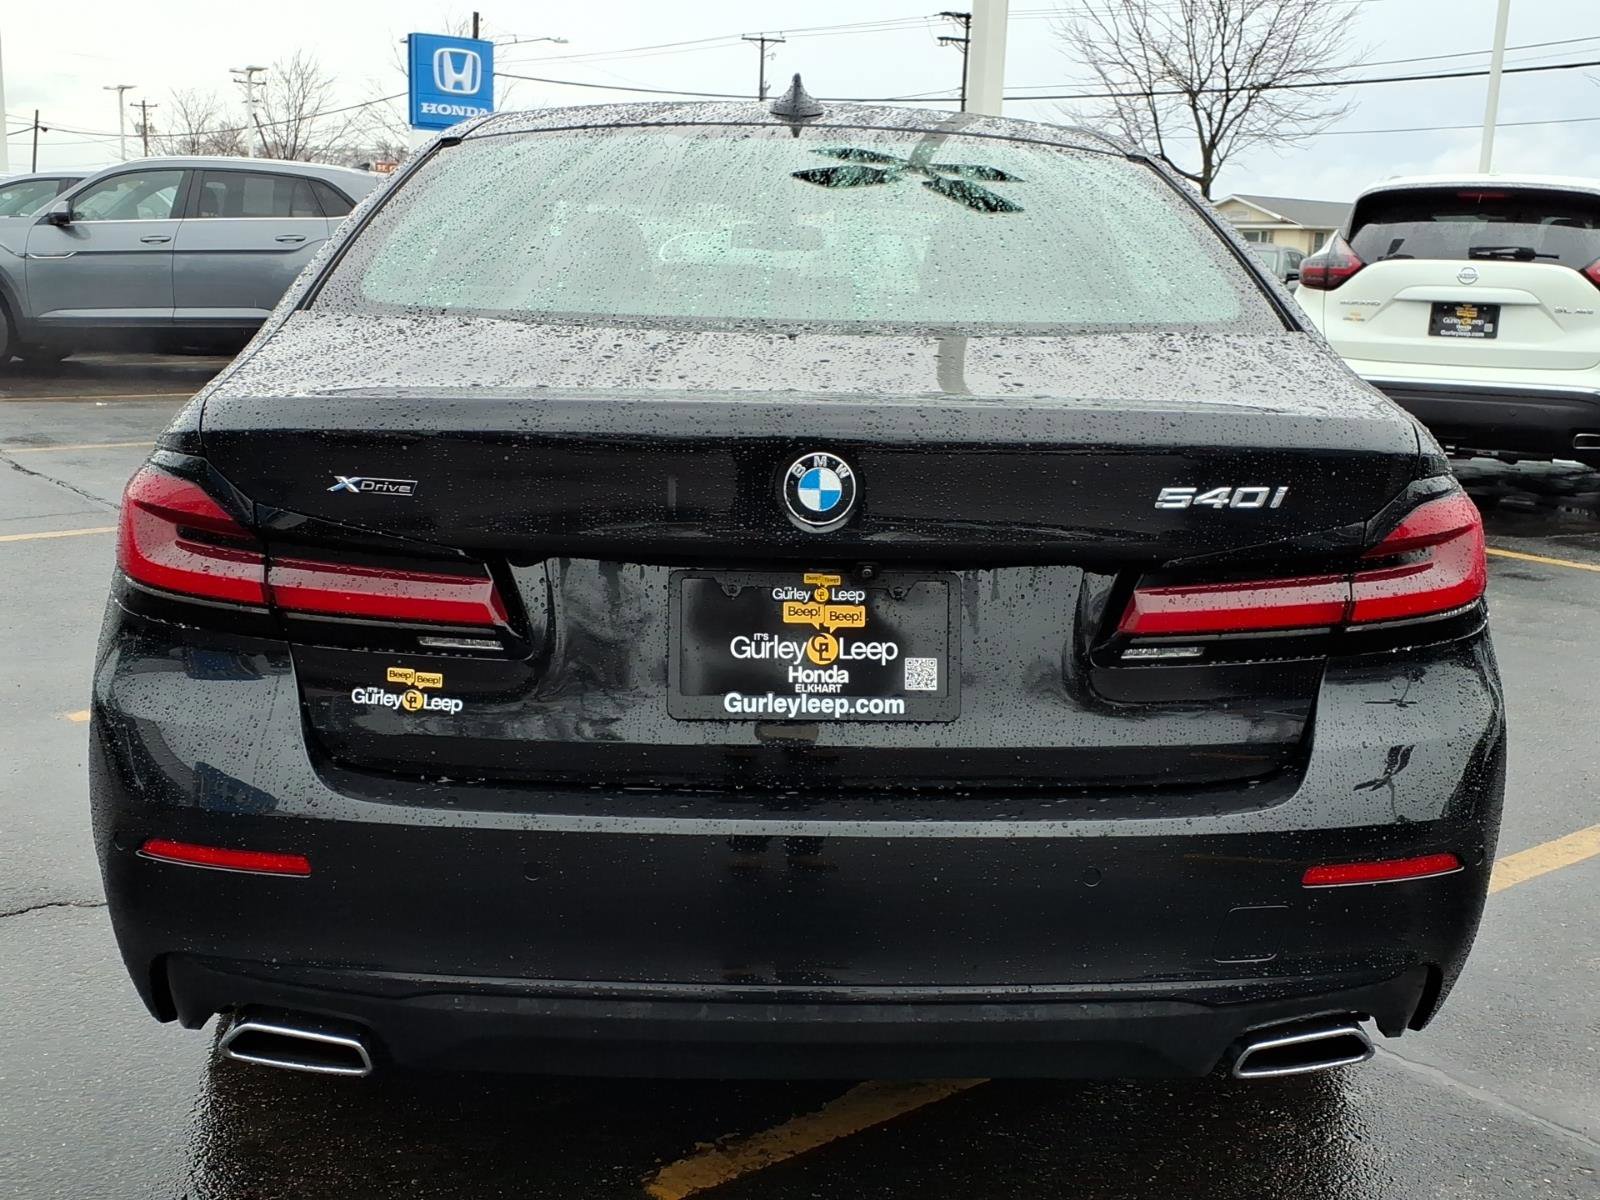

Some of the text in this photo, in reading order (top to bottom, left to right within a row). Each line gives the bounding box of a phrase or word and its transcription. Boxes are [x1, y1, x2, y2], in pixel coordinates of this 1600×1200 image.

[420, 102, 488, 117] HONDA
[791, 455, 850, 479] BMW
[1154, 486, 1289, 509] 540i
[772, 587, 866, 604] Gurley Leep
[787, 606, 822, 620] Beep!
[829, 611, 863, 624] Beep!
[730, 634, 808, 665] Gurley
[839, 637, 899, 666] Leep
[389, 669, 441, 685] Beep! Beep!
[788, 665, 849, 683] Honda
[795, 684, 842, 693] ELKHART
[351, 688, 403, 710] Gurley
[423, 693, 463, 714] Leep
[723, 692, 906, 718] Gurleyleep.com
